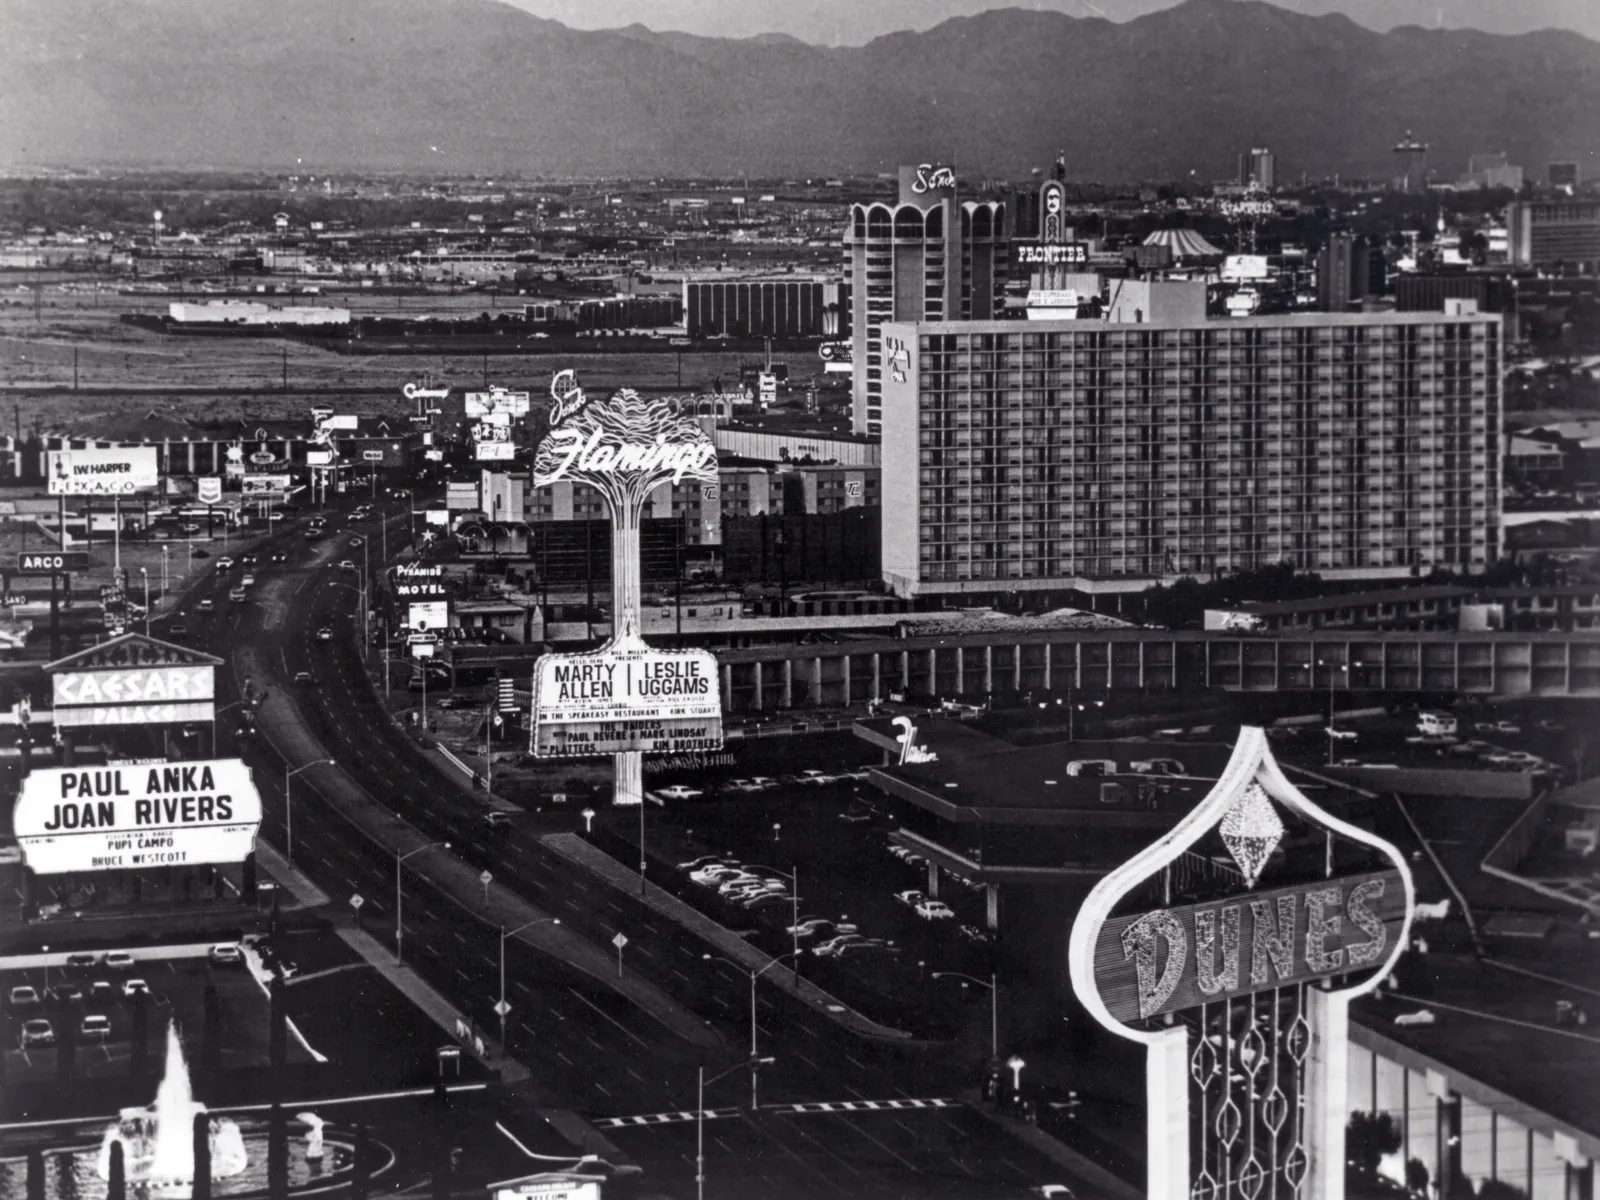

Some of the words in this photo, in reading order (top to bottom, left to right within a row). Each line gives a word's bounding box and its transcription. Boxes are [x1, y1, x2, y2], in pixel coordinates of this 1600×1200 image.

[912, 163, 955, 193] Sands
[1018, 246, 1086, 263] FRONTIER
[550, 424, 716, 487] Flamingo
[90, 462, 132, 475] HARPER
[23, 555, 64, 569] ARCO
[398, 584, 446, 595] MOTEL
[554, 664, 616, 682] MARTY
[644, 660, 700, 679] LESLIE
[58, 670, 210, 704] CAESARS
[559, 680, 613, 700] ALLEN
[638, 678, 708, 696] UGGAMS
[94, 704, 176, 724] PALACE
[552, 712, 564, 720] THE
[568, 710, 609, 719] SPEAKEASY
[614, 709, 660, 717] RESTAURANT
[690, 706, 716, 714] STUART
[568, 732, 590, 743] PAUL
[593, 730, 627, 742] REVERE
[640, 728, 665, 740] MARK
[669, 726, 707, 738] LINDSAY
[601, 721, 616, 732] THE
[622, 720, 662, 731] RAIDERS
[550, 742, 596, 755] PLATTERS
[653, 740, 670, 751] KIM
[674, 738, 721, 750] BROTHERS
[61, 770, 130, 799] PAUL
[146, 765, 216, 795] ANKA
[44, 800, 115, 831] JOAN
[135, 794, 233, 826] RIVERS
[108, 840, 133, 851] PUPI
[137, 837, 175, 849] CAMPO
[92, 855, 124, 867] BRUCE
[132, 851, 188, 864] WESTCOTT
[1121, 879, 1387, 1021] DUNES
